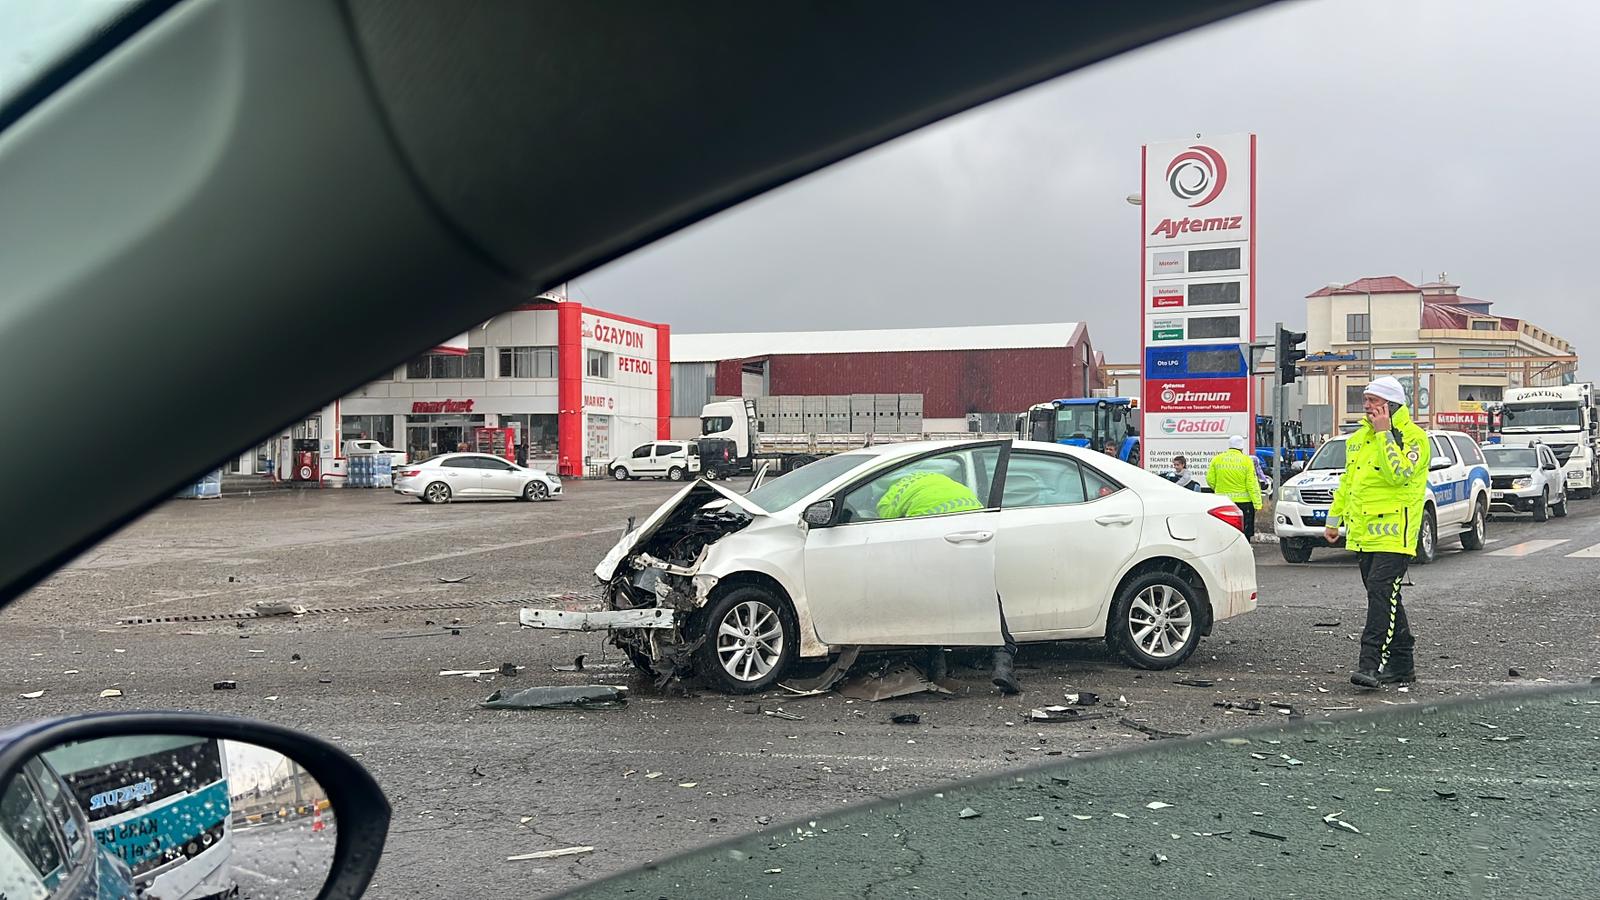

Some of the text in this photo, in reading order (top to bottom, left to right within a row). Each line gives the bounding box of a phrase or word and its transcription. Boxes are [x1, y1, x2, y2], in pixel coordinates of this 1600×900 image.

[1151, 215, 1243, 239] Aytemiz
[594, 318, 644, 349] ÖZAYDIN
[618, 356, 653, 375] PETROL
[584, 395, 606, 407] MARKET
[1161, 389, 1231, 405] Optimum
[411, 398, 474, 413] market
[1177, 418, 1225, 433] Castrol
[1437, 412, 1475, 424] MEDİKAL
